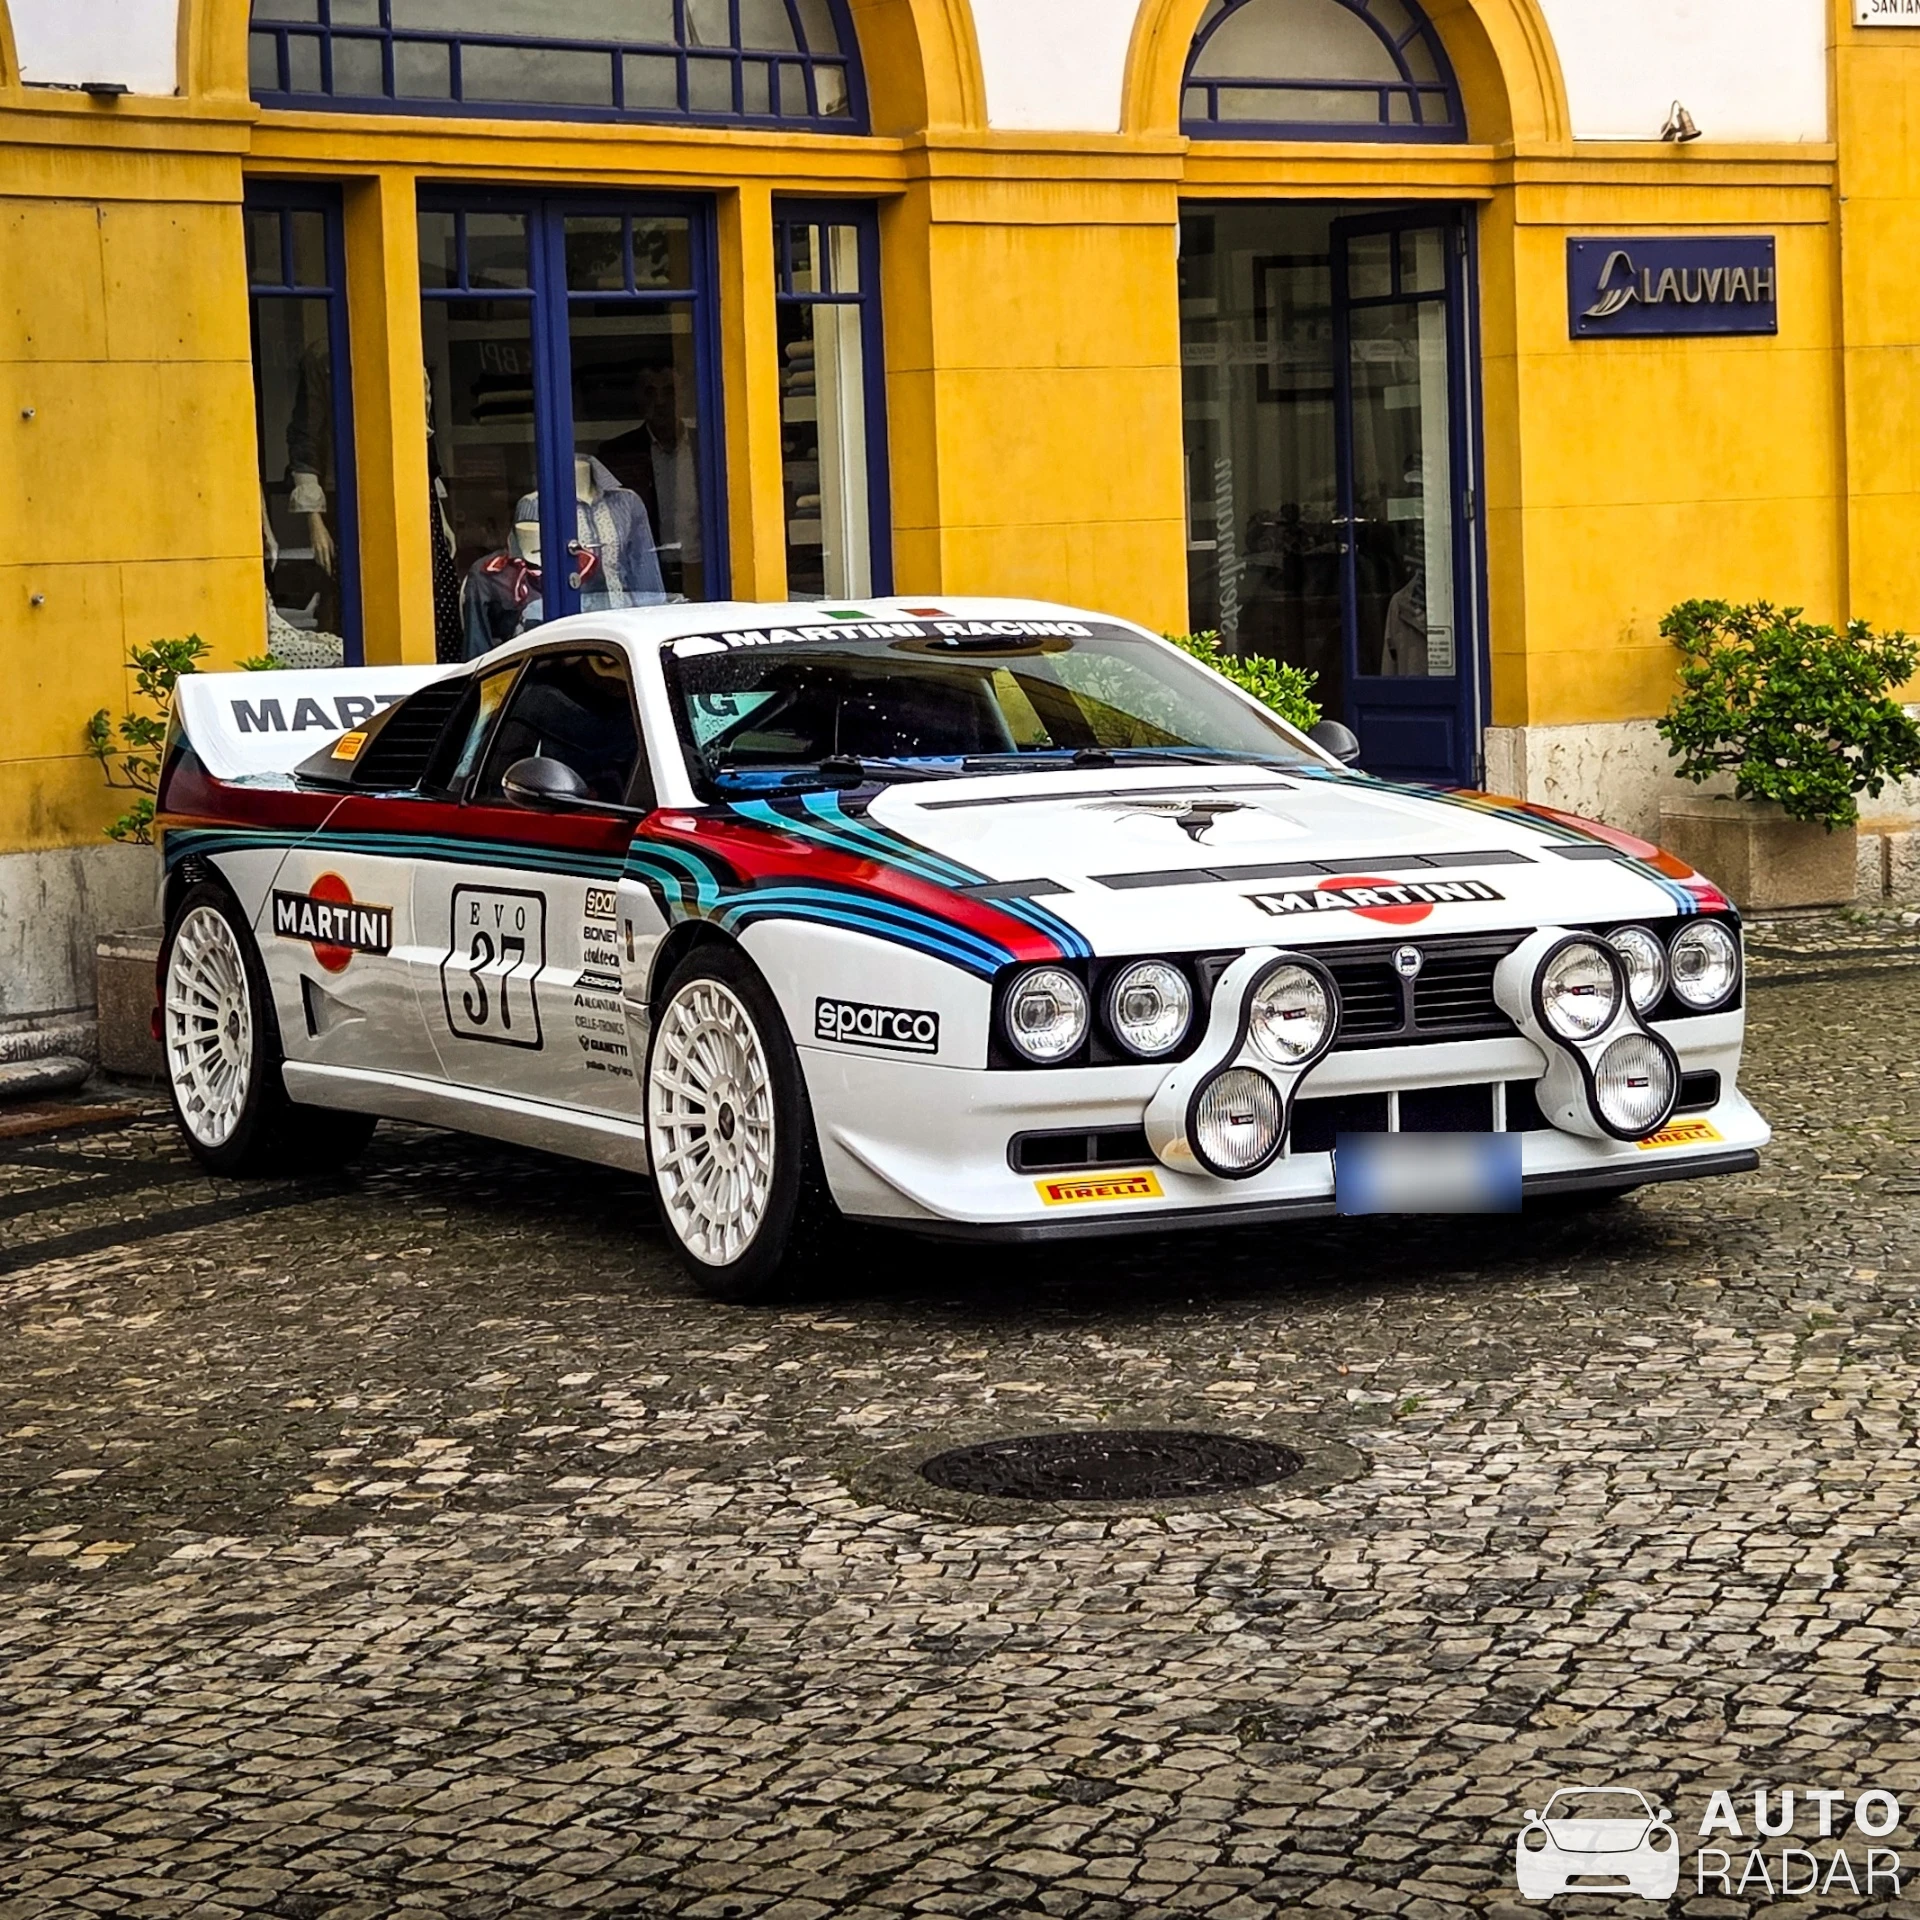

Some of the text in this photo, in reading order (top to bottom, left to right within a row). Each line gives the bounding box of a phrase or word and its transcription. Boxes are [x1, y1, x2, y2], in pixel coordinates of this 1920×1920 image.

[1643, 266, 1774, 303] LAUVIAH
[722, 621, 1094, 647] MARTINI RACING
[1255, 880, 1496, 915] MARTINI
[276, 897, 389, 949] MARTINI
[469, 901, 526, 931] EVO
[463, 931, 526, 1030] 37
[818, 1002, 936, 1042] sparco
[1046, 1177, 1151, 1200] PIRELLI
